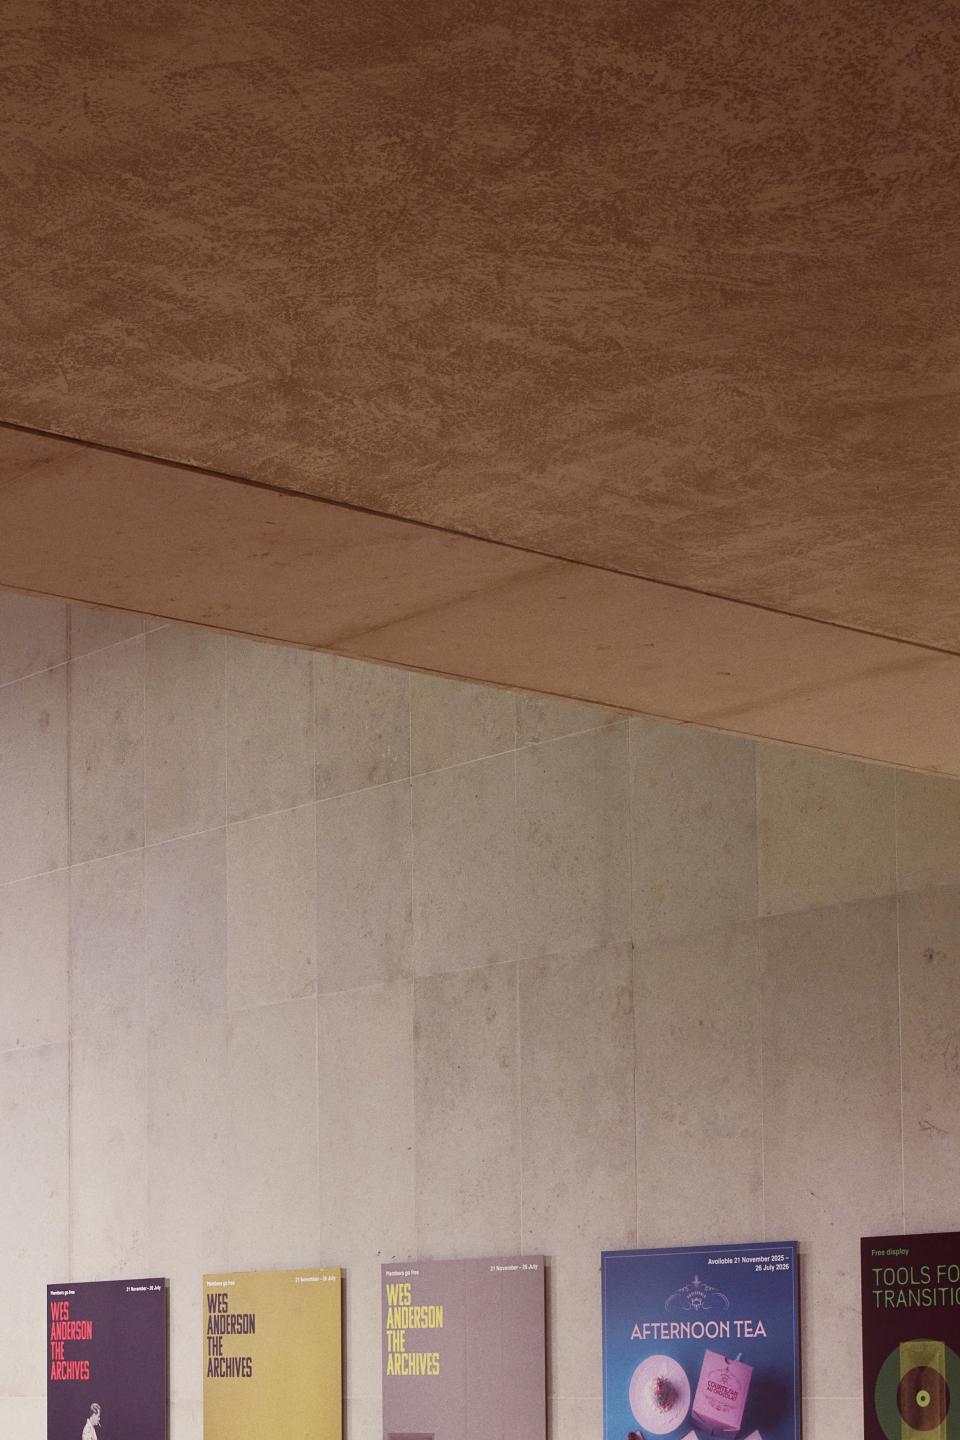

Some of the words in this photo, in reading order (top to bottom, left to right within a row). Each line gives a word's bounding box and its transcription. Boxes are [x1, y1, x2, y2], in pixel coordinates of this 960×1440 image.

[708, 1257, 733, 1265] Available
[734, 1256, 740, 1264] 21
[741, 1255, 770, 1263] November
[886, 1248, 909, 1256] display
[528, 1263, 538, 1271] July
[763, 1264, 775, 1272] July
[872, 1265, 932, 1287] TOOLS
[207, 1293, 229, 1314] WES
[386, 1283, 411, 1306] WES
[50, 1301, 69, 1321] WES
[386, 1305, 443, 1329] ANDERSON
[50, 1320, 93, 1341] ANDERSON
[207, 1313, 256, 1335] ANDERSON
[630, 1320, 730, 1340] AFTERNOON
[733, 1319, 767, 1338] TEA
[50, 1341, 65, 1360] THE
[207, 1336, 224, 1356] THE
[386, 1330, 405, 1352] THE
[50, 1360, 90, 1380] ARCHIVES
[207, 1357, 253, 1378] ARCHIVES
[386, 1353, 440, 1376] ARCHIVES
